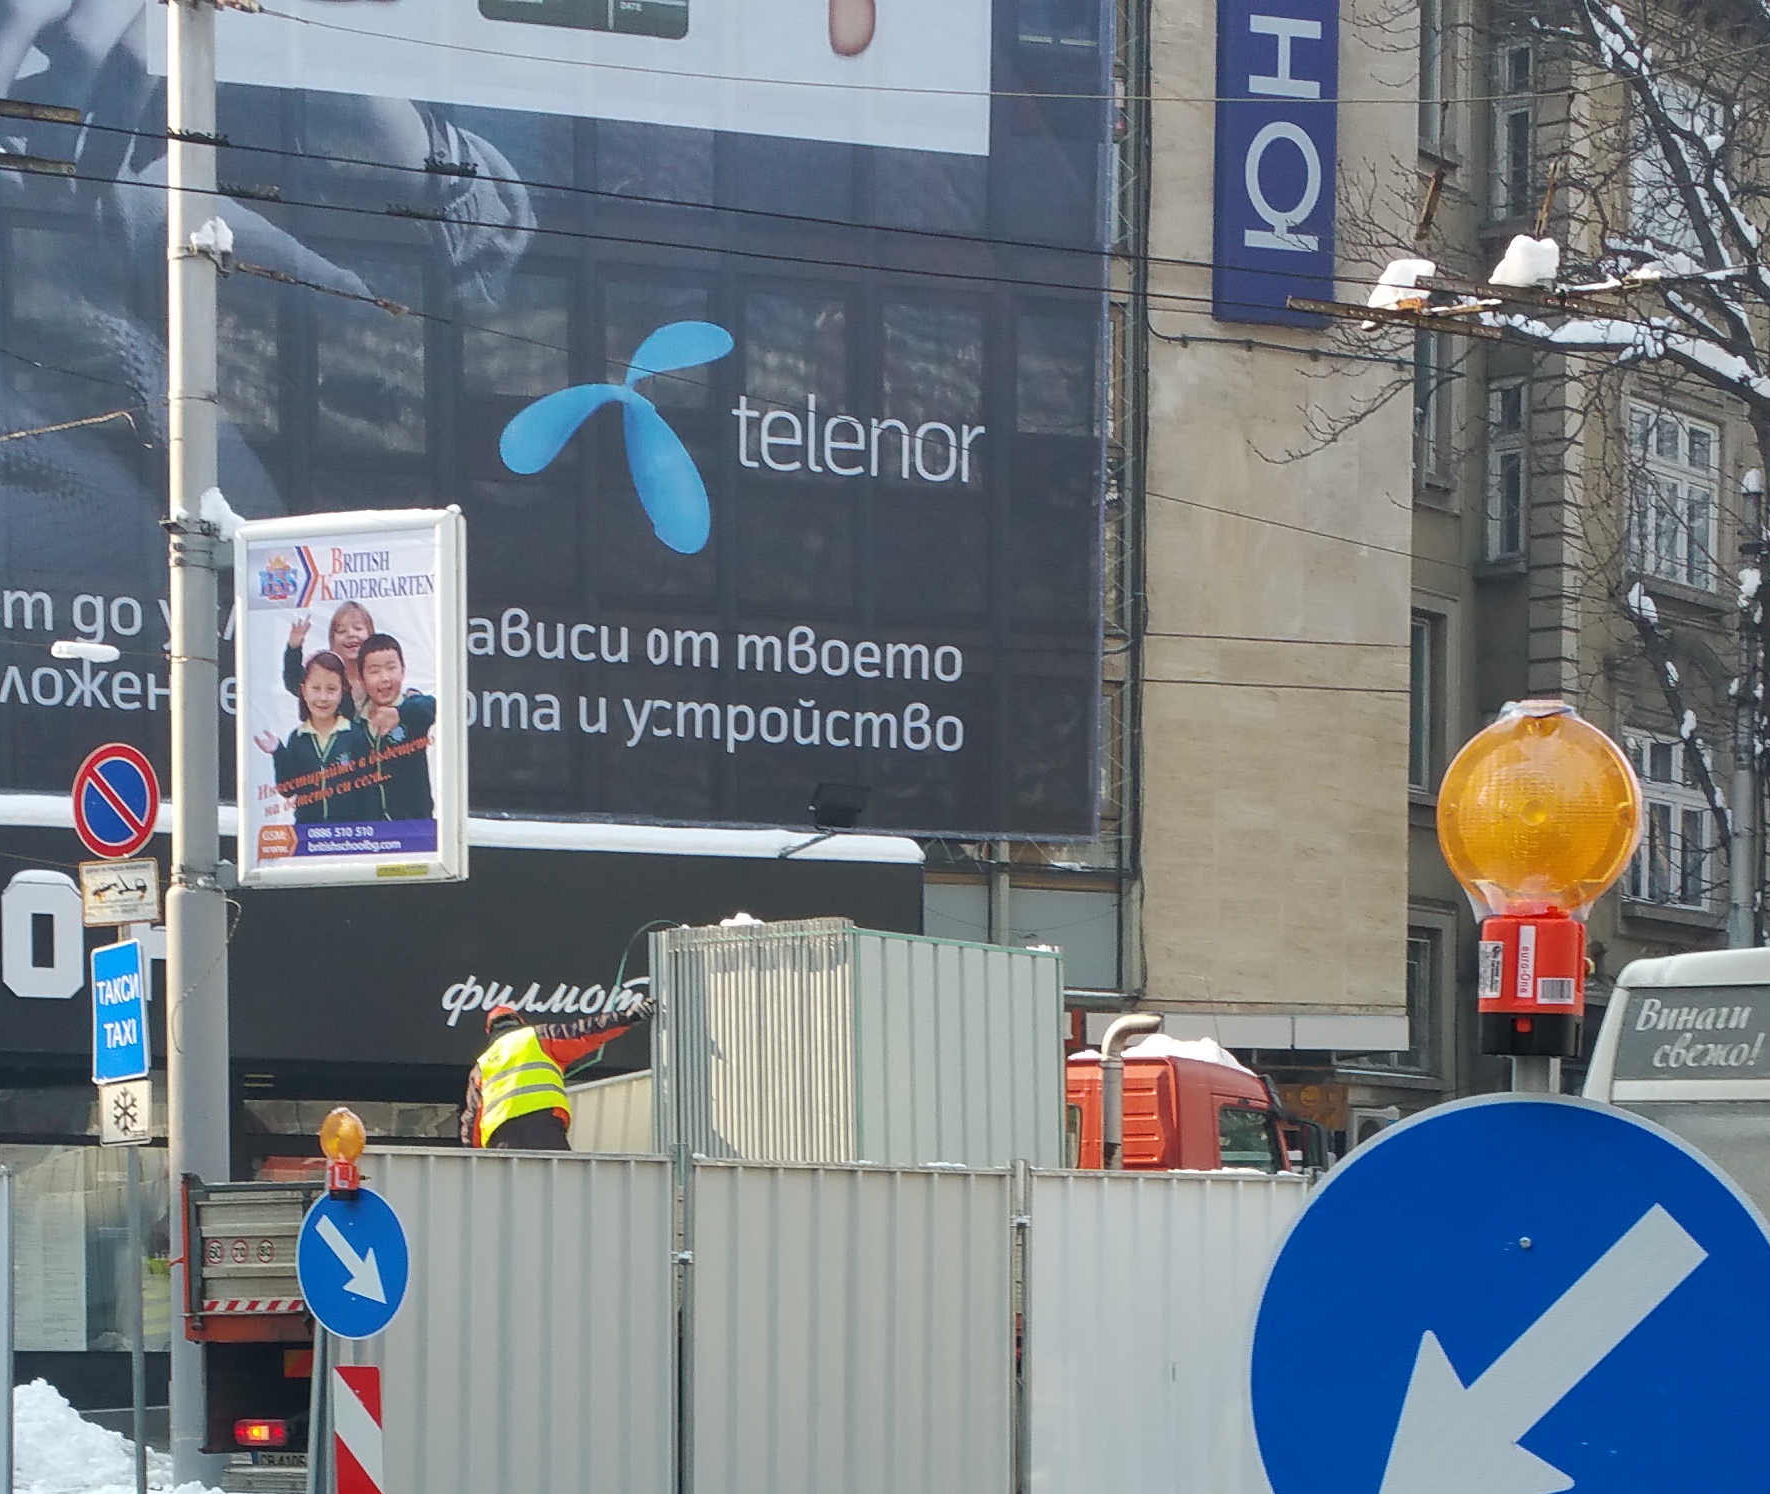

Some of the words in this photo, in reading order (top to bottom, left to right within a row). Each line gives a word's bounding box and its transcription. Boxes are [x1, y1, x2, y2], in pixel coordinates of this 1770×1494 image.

[731, 394, 985, 483] telenor
[331, 547, 390, 575] BRITISH
[319, 574, 435, 602] KINDERGARTEN
[71, 592, 146, 644] до
[467, 606, 629, 665] ависи
[645, 627, 720, 668] от
[736, 626, 964, 682] твоето
[579, 694, 608, 734] и
[623, 694, 965, 753] устройство
[96, 972, 141, 1006] ТАКСИ
[441, 975, 651, 1028] филмот
[1635, 998, 1752, 1031] Винаги
[103, 1018, 138, 1048] TAXI
[1652, 1032, 1766, 1067] свежо!
